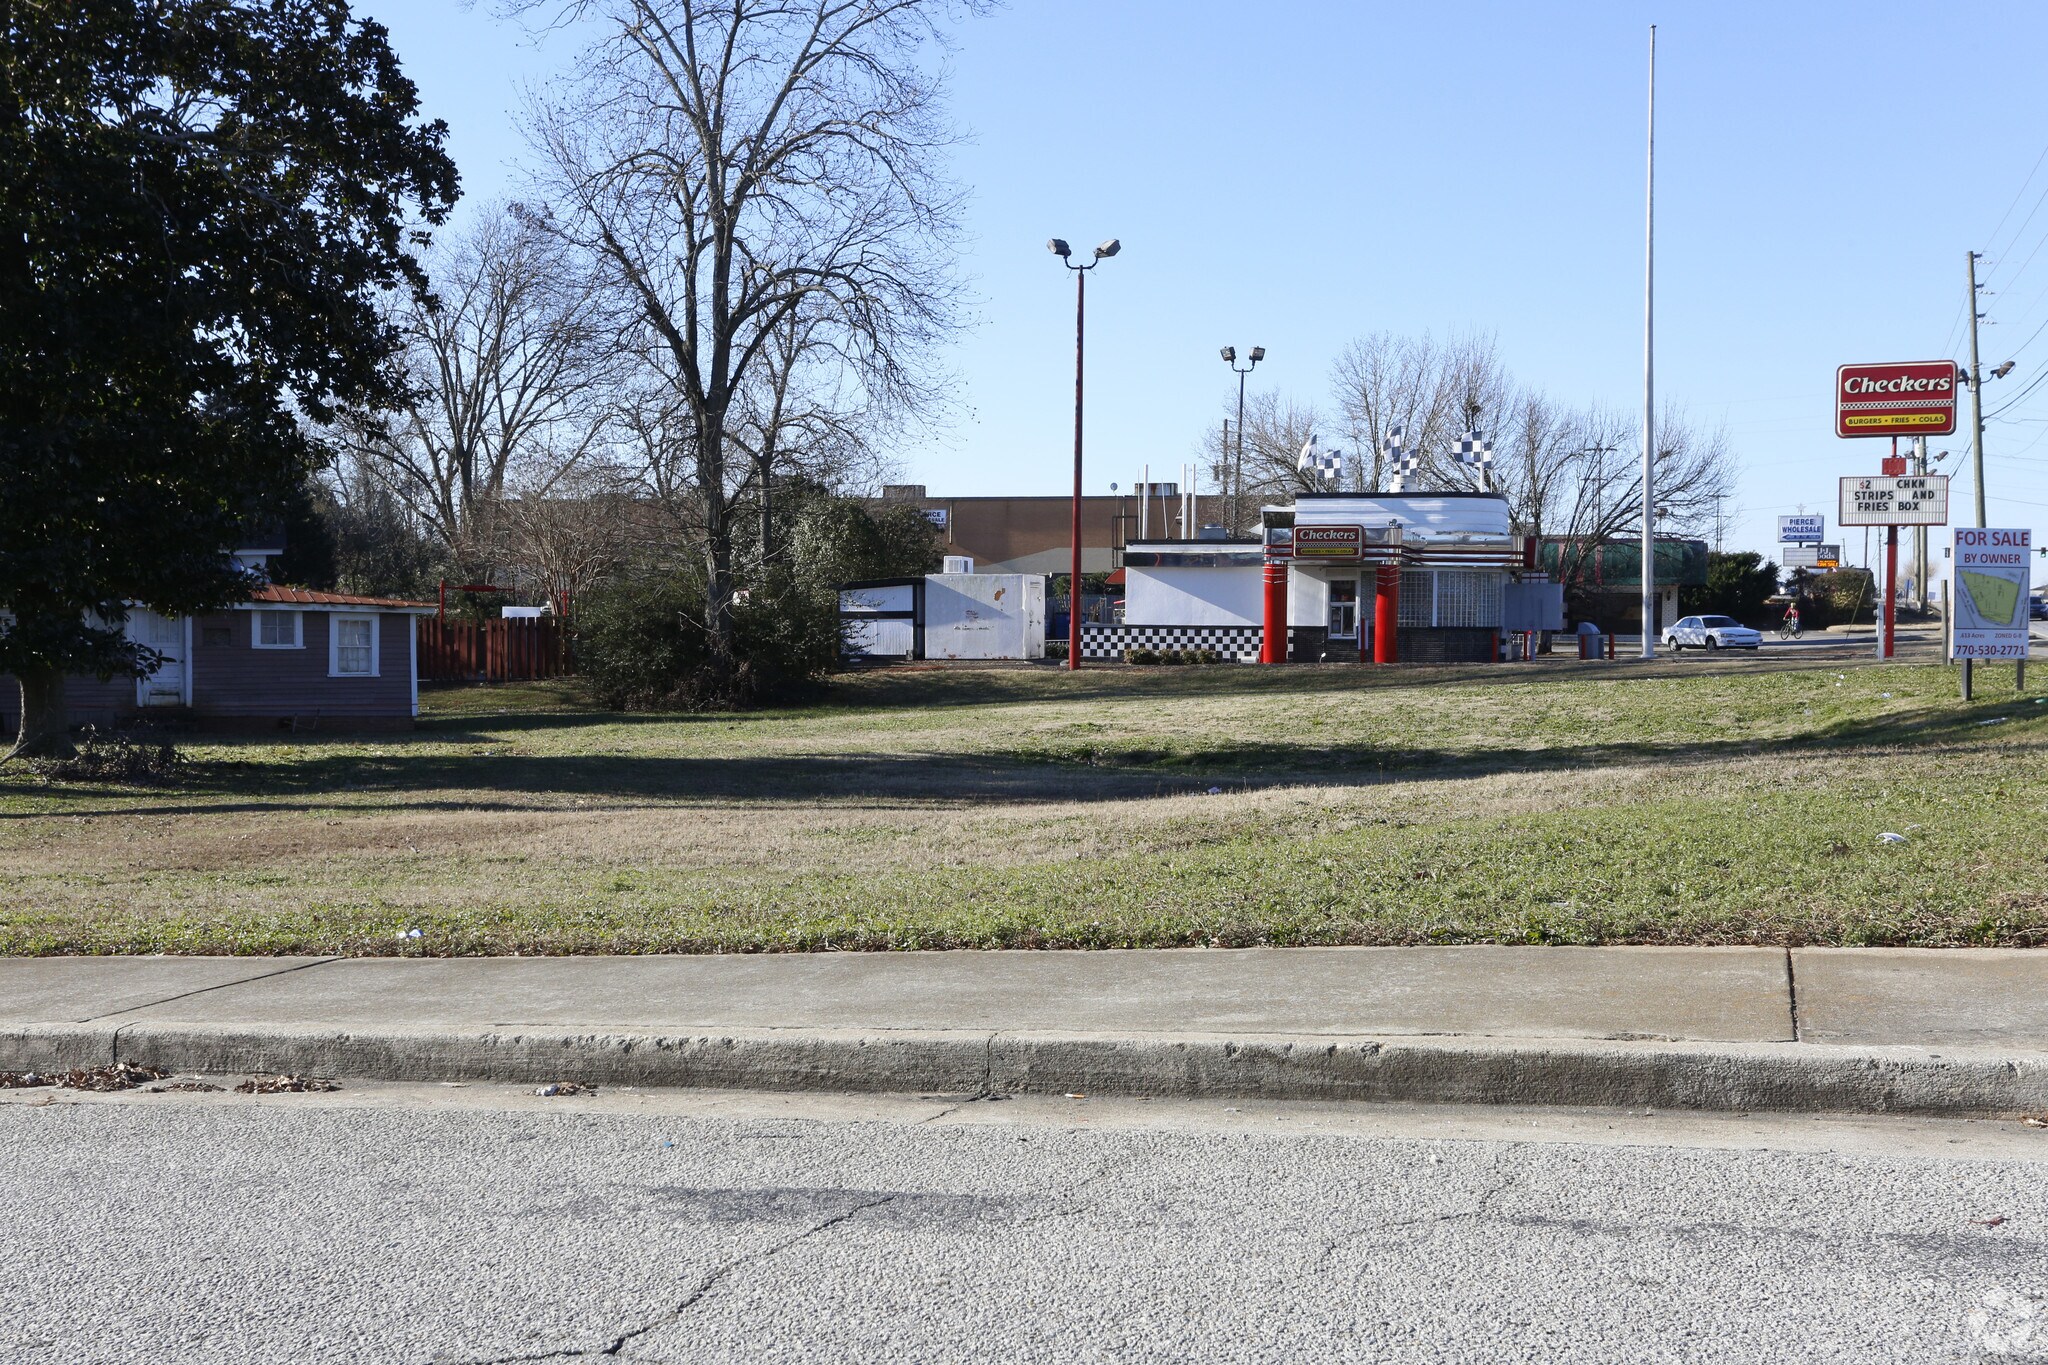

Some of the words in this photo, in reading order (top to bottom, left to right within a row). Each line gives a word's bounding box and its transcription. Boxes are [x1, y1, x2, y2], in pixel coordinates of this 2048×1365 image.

[1844, 375, 1950, 394] Checkers
[1848, 417, 1882, 425] BURGERS
[1891, 416, 1910, 424] FRIES
[1860, 480, 1871, 489] $2
[1896, 479, 1925, 489] CHKN
[1854, 491, 1894, 500] STRIPS
[1912, 490, 1935, 499] AND
[1858, 502, 1889, 511] FRIES
[1898, 501, 1920, 511] BOX
[1300, 529, 1356, 540] Checkers
[1956, 531, 1987, 546] FOR
[1992, 531, 2029, 547] SALE
[1964, 553, 1978, 563] BY
[1980, 553, 2021, 564] OWNER
[1955, 645, 2025, 655] 770-530-2771
